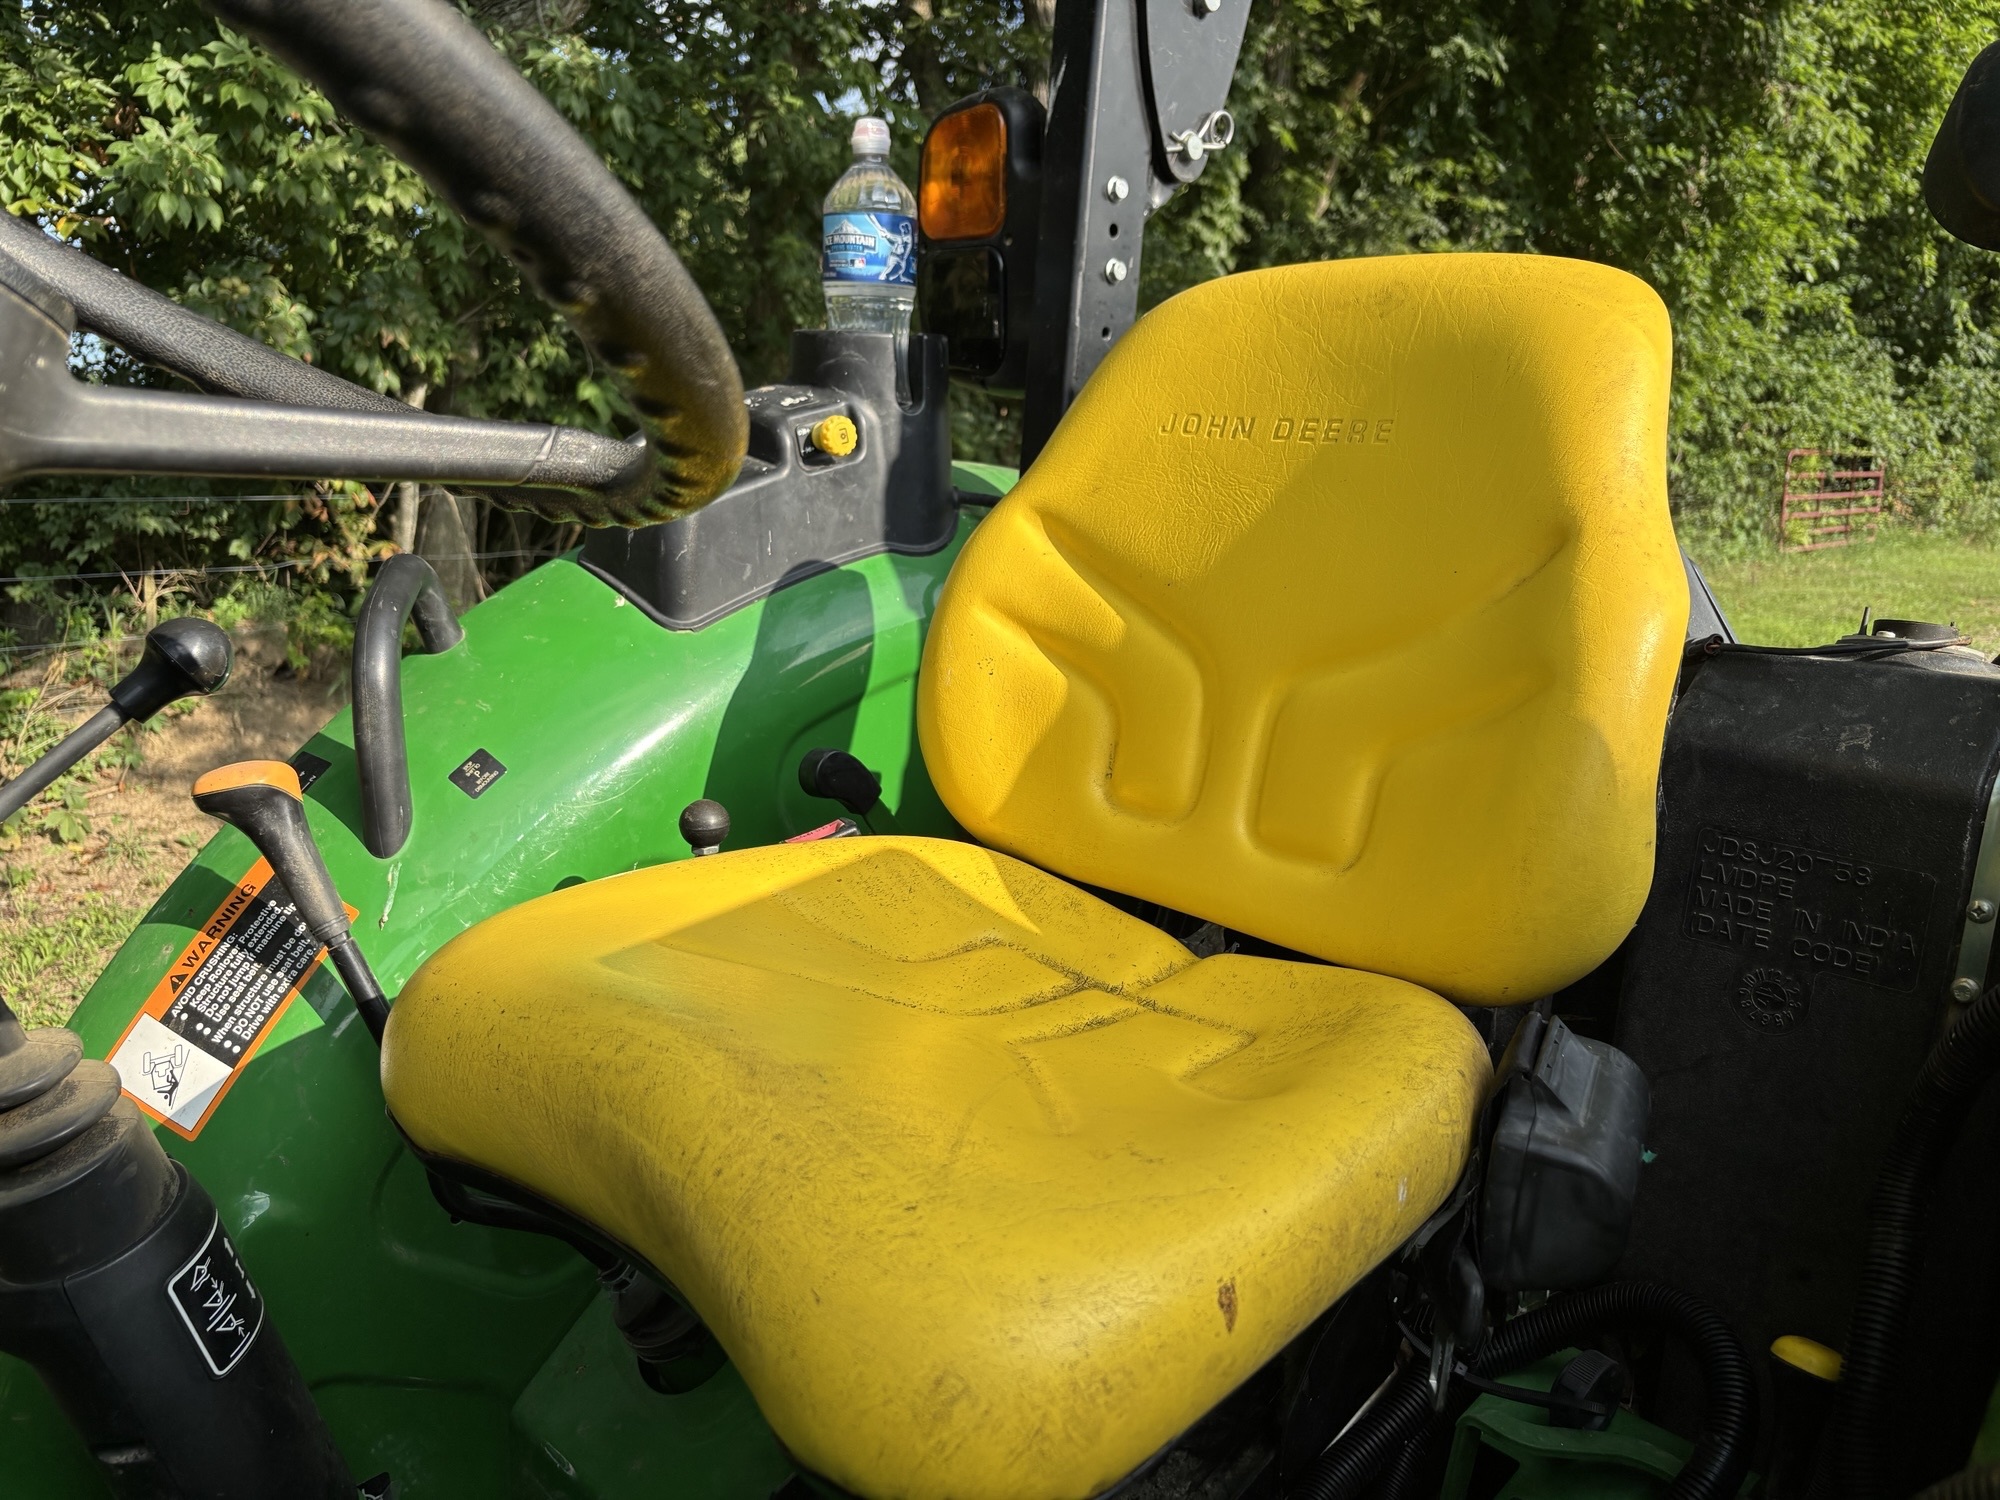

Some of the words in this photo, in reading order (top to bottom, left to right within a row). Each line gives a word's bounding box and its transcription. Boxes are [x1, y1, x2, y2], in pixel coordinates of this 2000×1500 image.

[833, 234, 875, 248] MOUNTAIN
[1158, 412, 1256, 441] JOHN
[1270, 416, 1395, 445] DEERE
[1696, 886, 1773, 922] MADE
[1794, 908, 1821, 934] IN
[1843, 919, 1916, 958] INDIA
[1700, 860, 1796, 899] LMDPE
[182, 883, 256, 968] WARNING
[189, 983, 213, 1009] Keep
[208, 945, 240, 983] Rollover
[239, 900, 277, 944] Protective
[197, 970, 233, 1013] Structure
[229, 949, 249, 969] fully
[248, 906, 284, 947] extended.
[204, 1003, 219, 1018] Do
[216, 985, 232, 1003] not
[228, 962, 252, 988] jump
[255, 916, 286, 953] machine
[171, 986, 196, 1018] AVOID
[193, 932, 239, 987] CRUSHING:
[211, 1016, 237, 1045] When
[233, 974, 268, 1017] structure
[264, 950, 286, 974] must
[282, 936, 296, 950] be
[212, 1003, 231, 1023] Use
[228, 982, 247, 1003] seat
[243, 963, 262, 982] belt.
[232, 1018, 248, 1036] DO
[244, 995, 264, 1019] NOT
[261, 978, 279, 998] use
[276, 958, 294, 979] seat
[291, 935, 311, 957] belt.
[241, 1013, 264, 1041] Drive
[260, 993, 280, 1015] with
[276, 970, 298, 994] extra
[296, 944, 316, 968] care.
